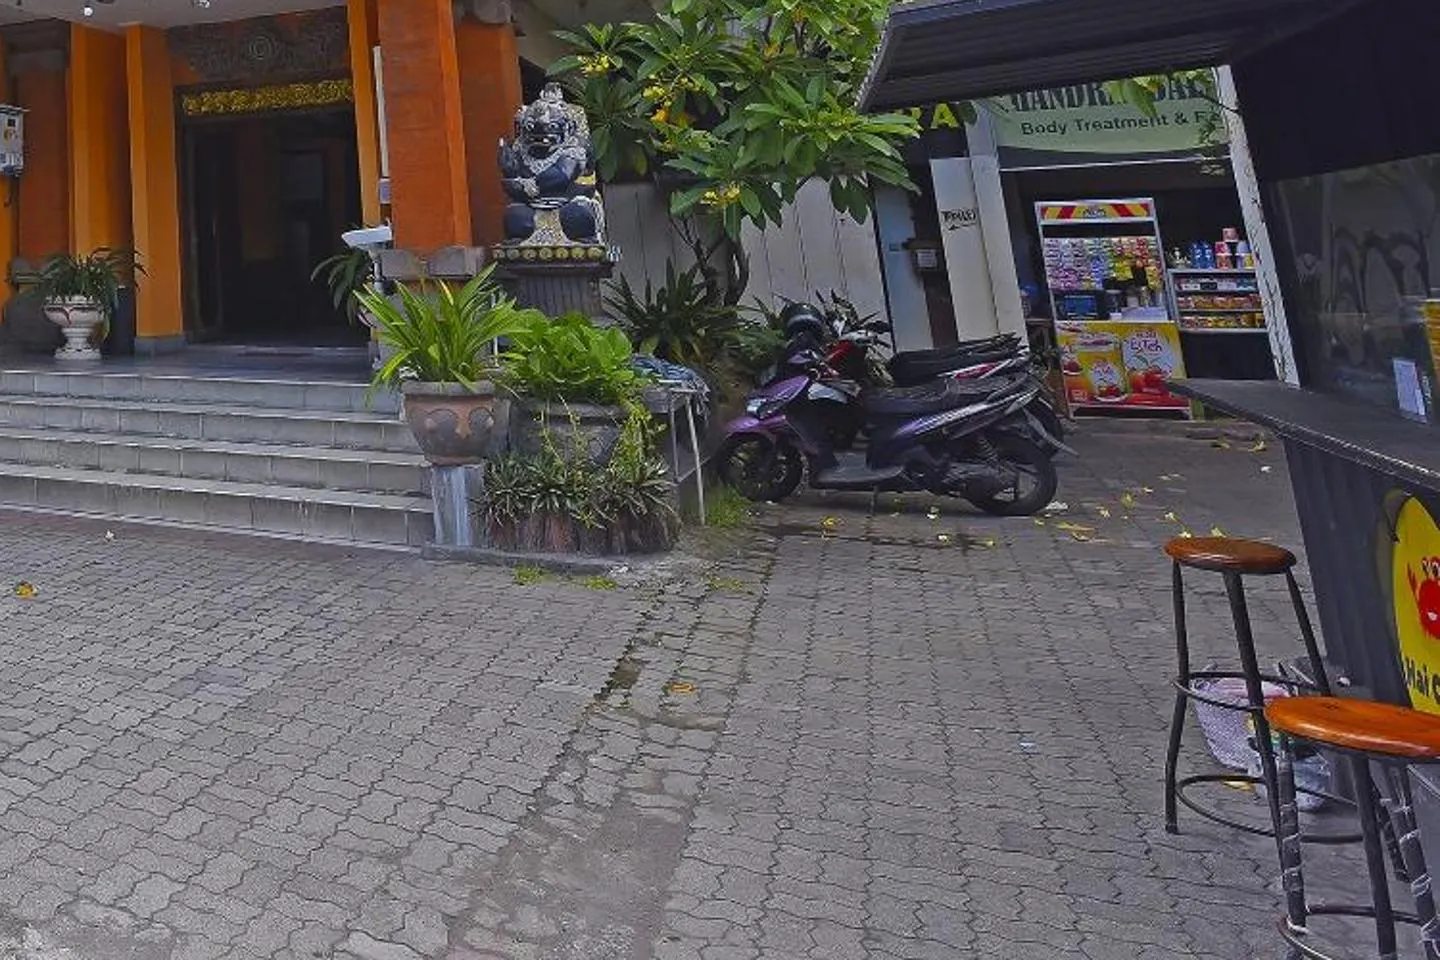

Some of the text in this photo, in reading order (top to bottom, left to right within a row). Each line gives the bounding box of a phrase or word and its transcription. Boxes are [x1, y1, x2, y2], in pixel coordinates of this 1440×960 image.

[1020, 121, 1067, 136] Body
[1074, 114, 1169, 132] Treatment
[1174, 111, 1189, 126] &
